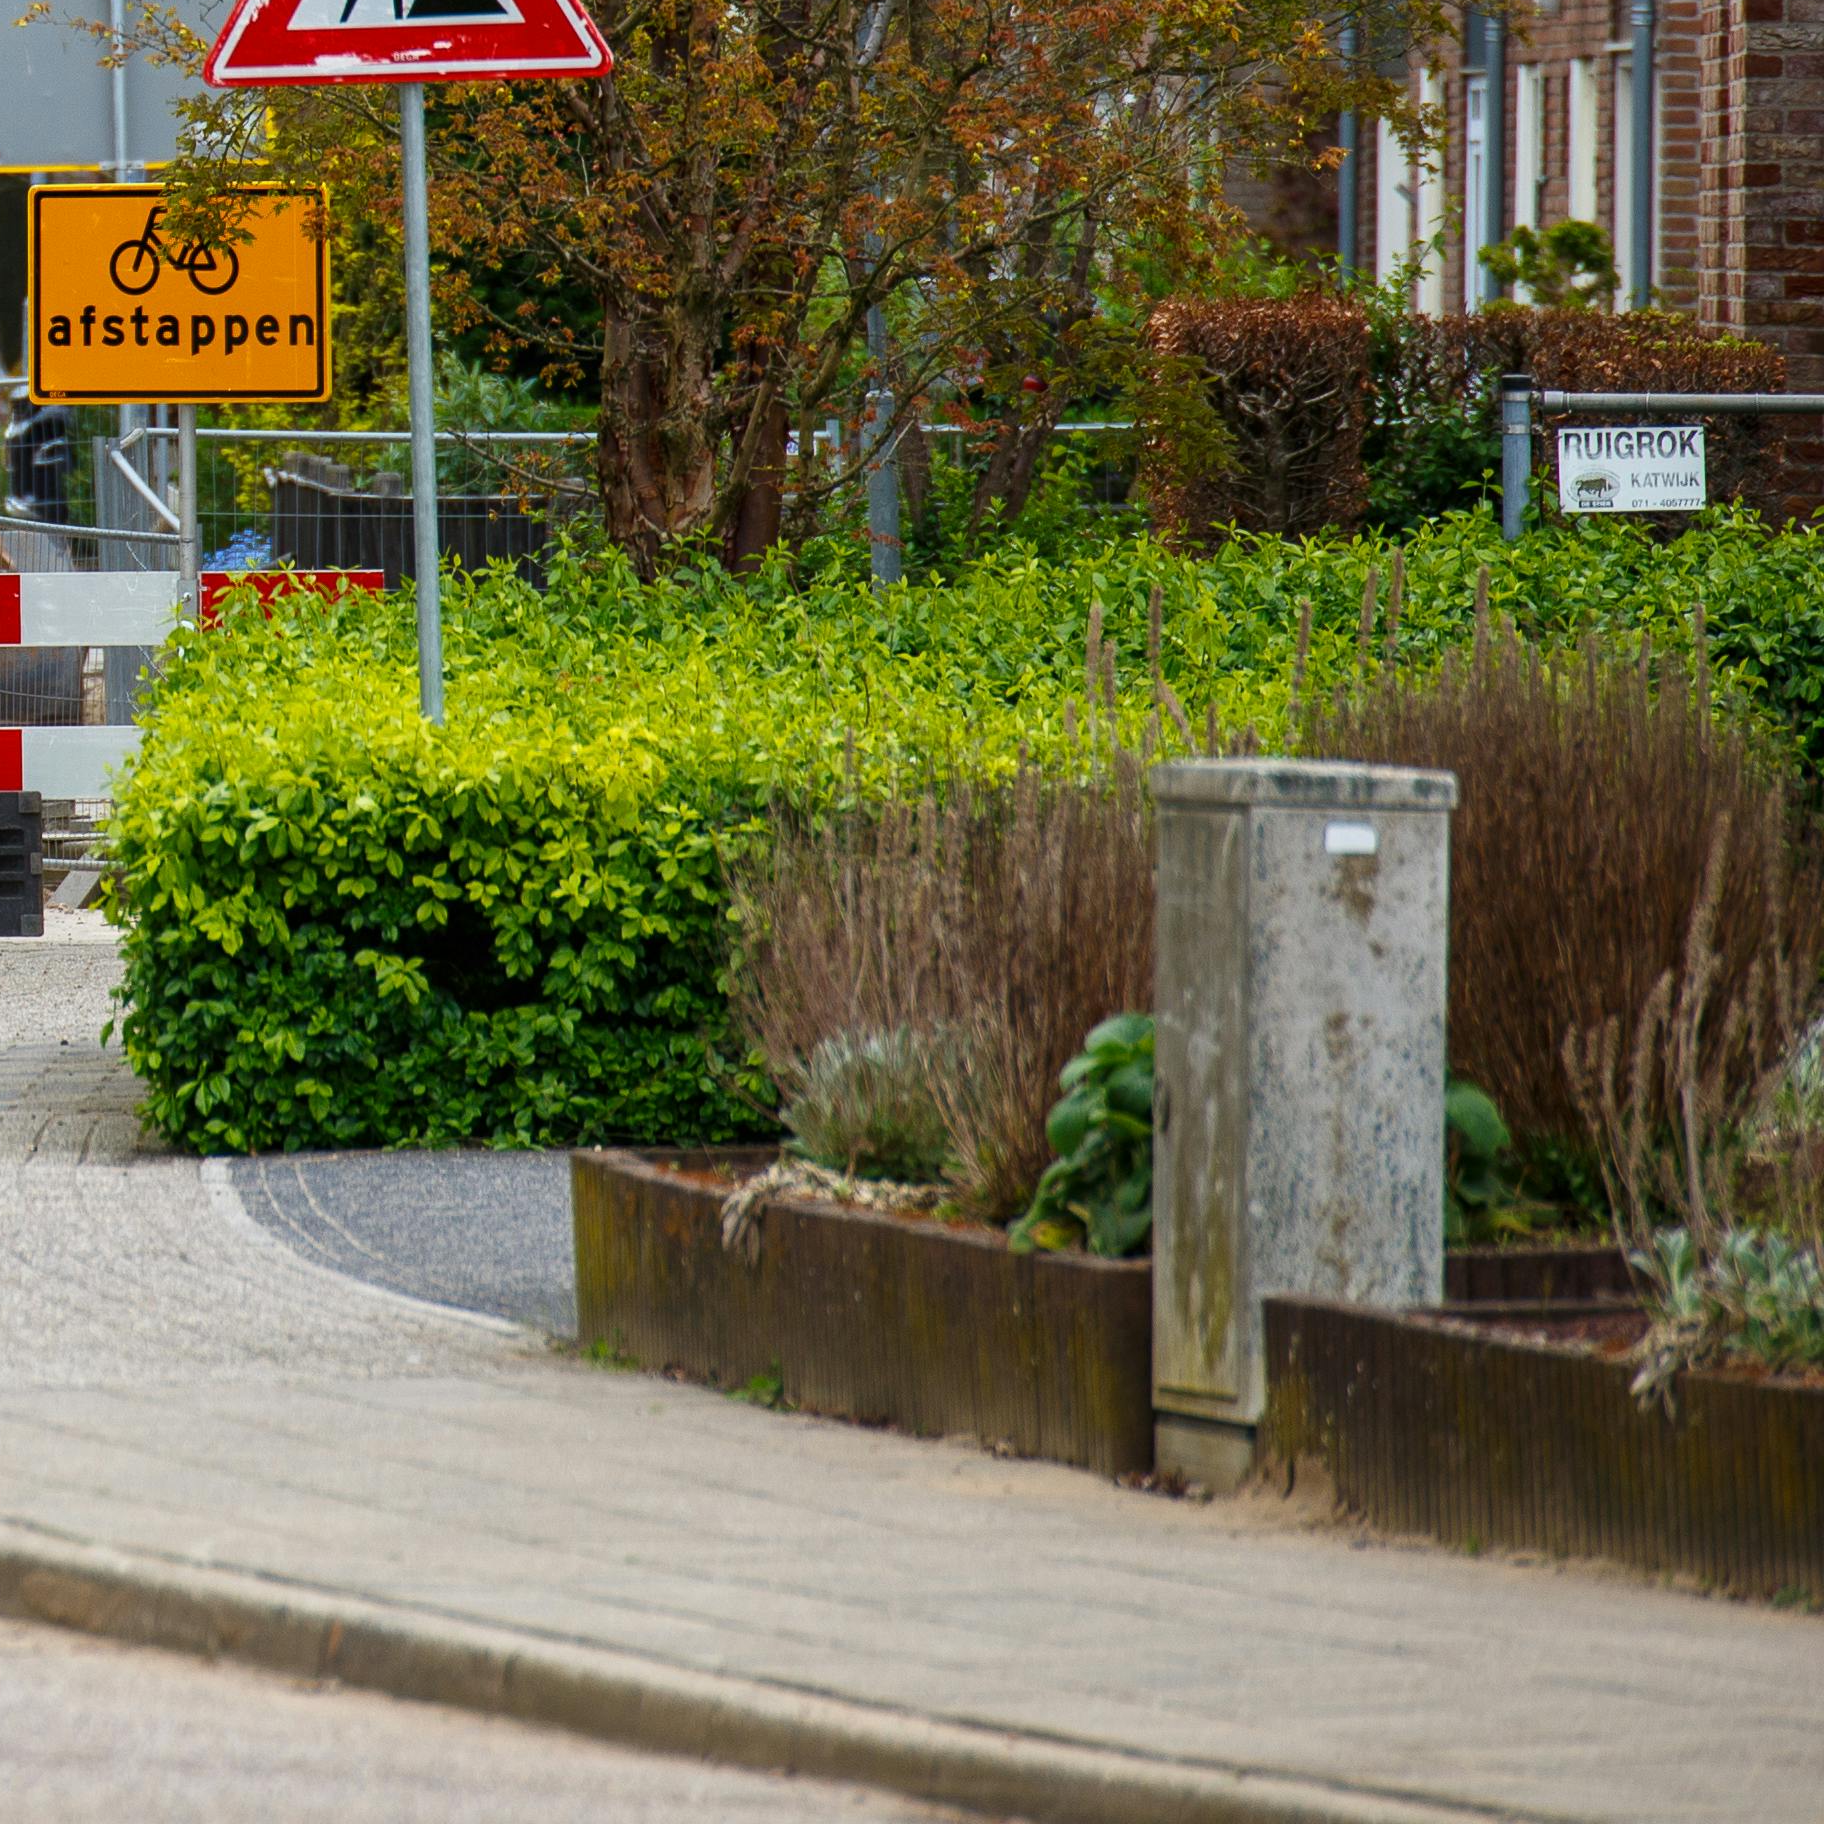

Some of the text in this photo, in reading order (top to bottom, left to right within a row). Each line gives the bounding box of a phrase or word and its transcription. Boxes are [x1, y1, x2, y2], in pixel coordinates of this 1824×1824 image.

[47, 305, 314, 356] afstappen
[1563, 429, 1700, 460] RUIGROK
[1631, 472, 1700, 488] KATWIJK
